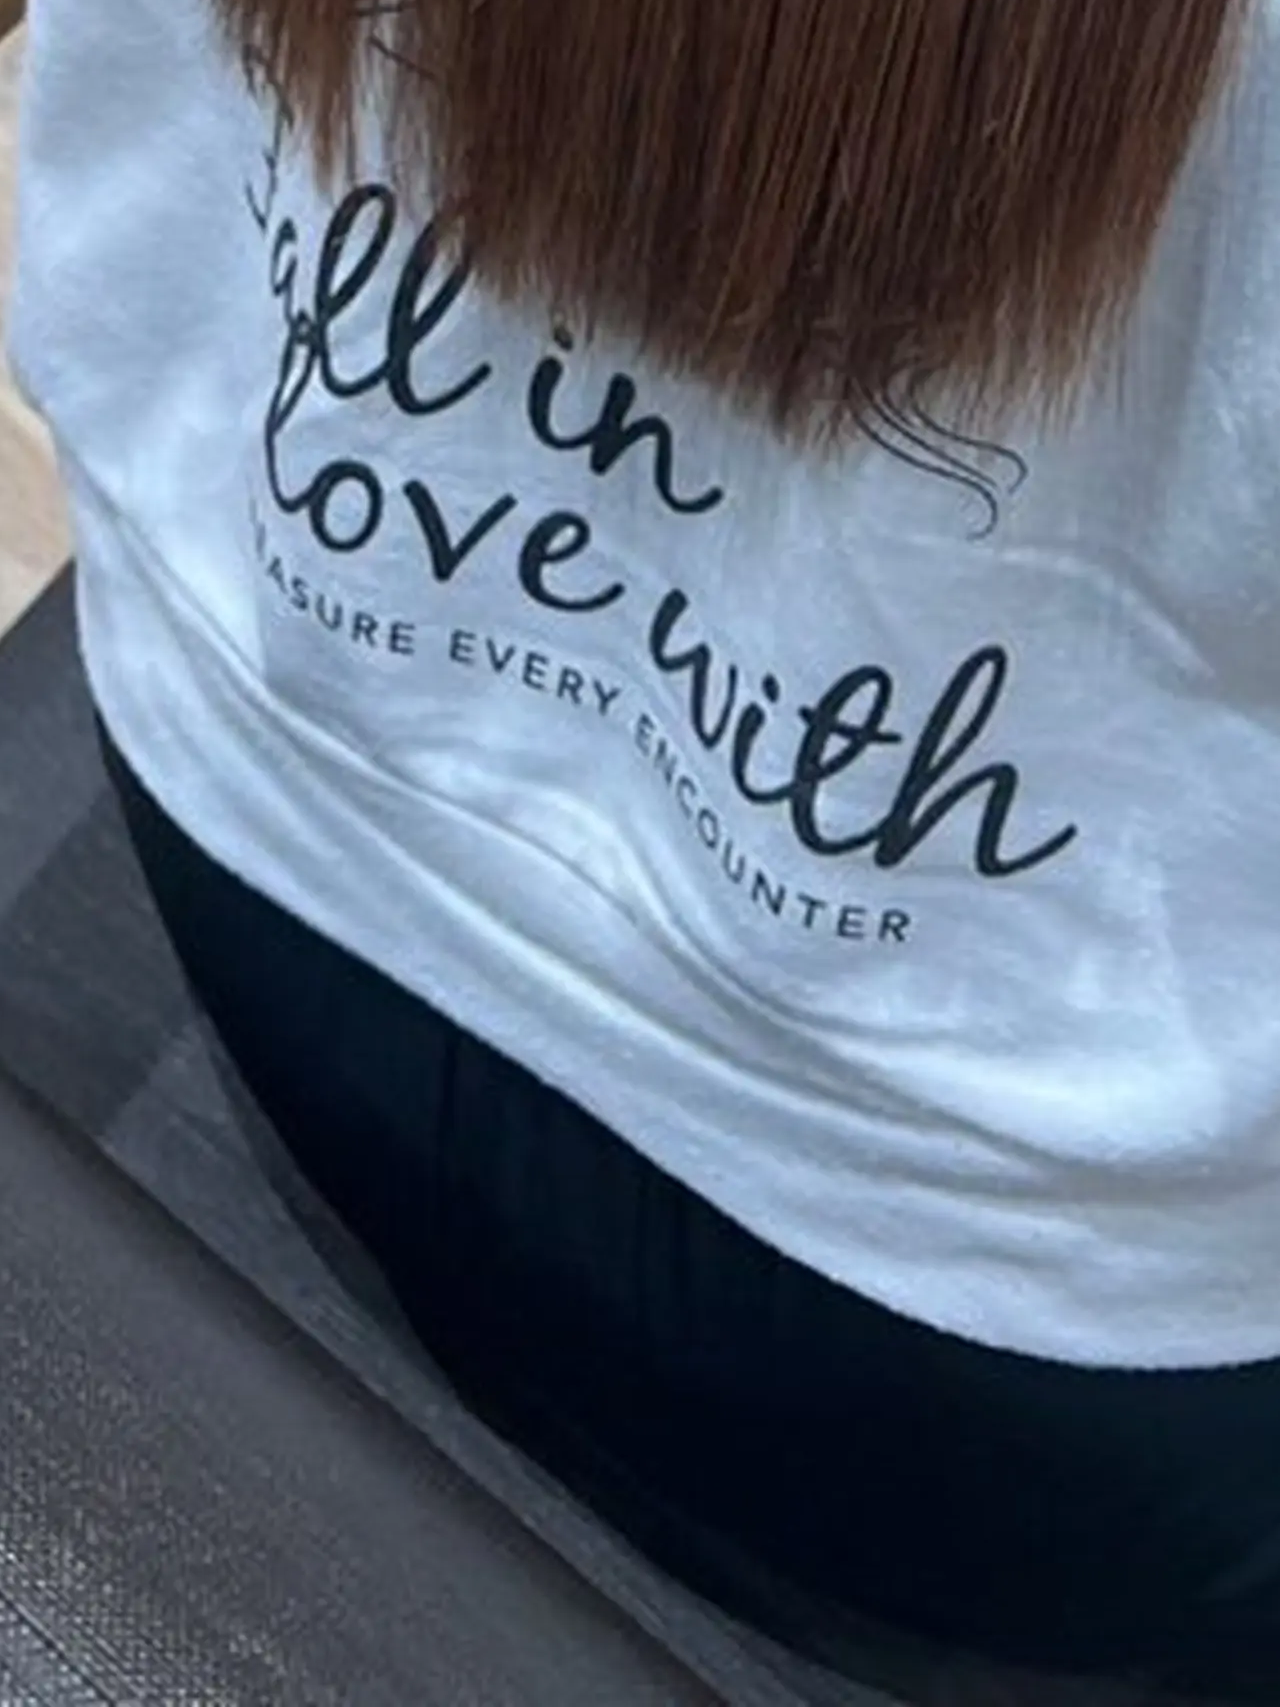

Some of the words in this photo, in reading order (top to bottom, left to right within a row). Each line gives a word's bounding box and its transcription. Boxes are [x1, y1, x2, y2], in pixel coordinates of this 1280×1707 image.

[527, 324, 724, 514] in
[265, 309, 625, 612] love
[648, 587, 1078, 879] with
[449, 628, 622, 716] EVERY
[633, 712, 913, 943] ENCOUNTER
